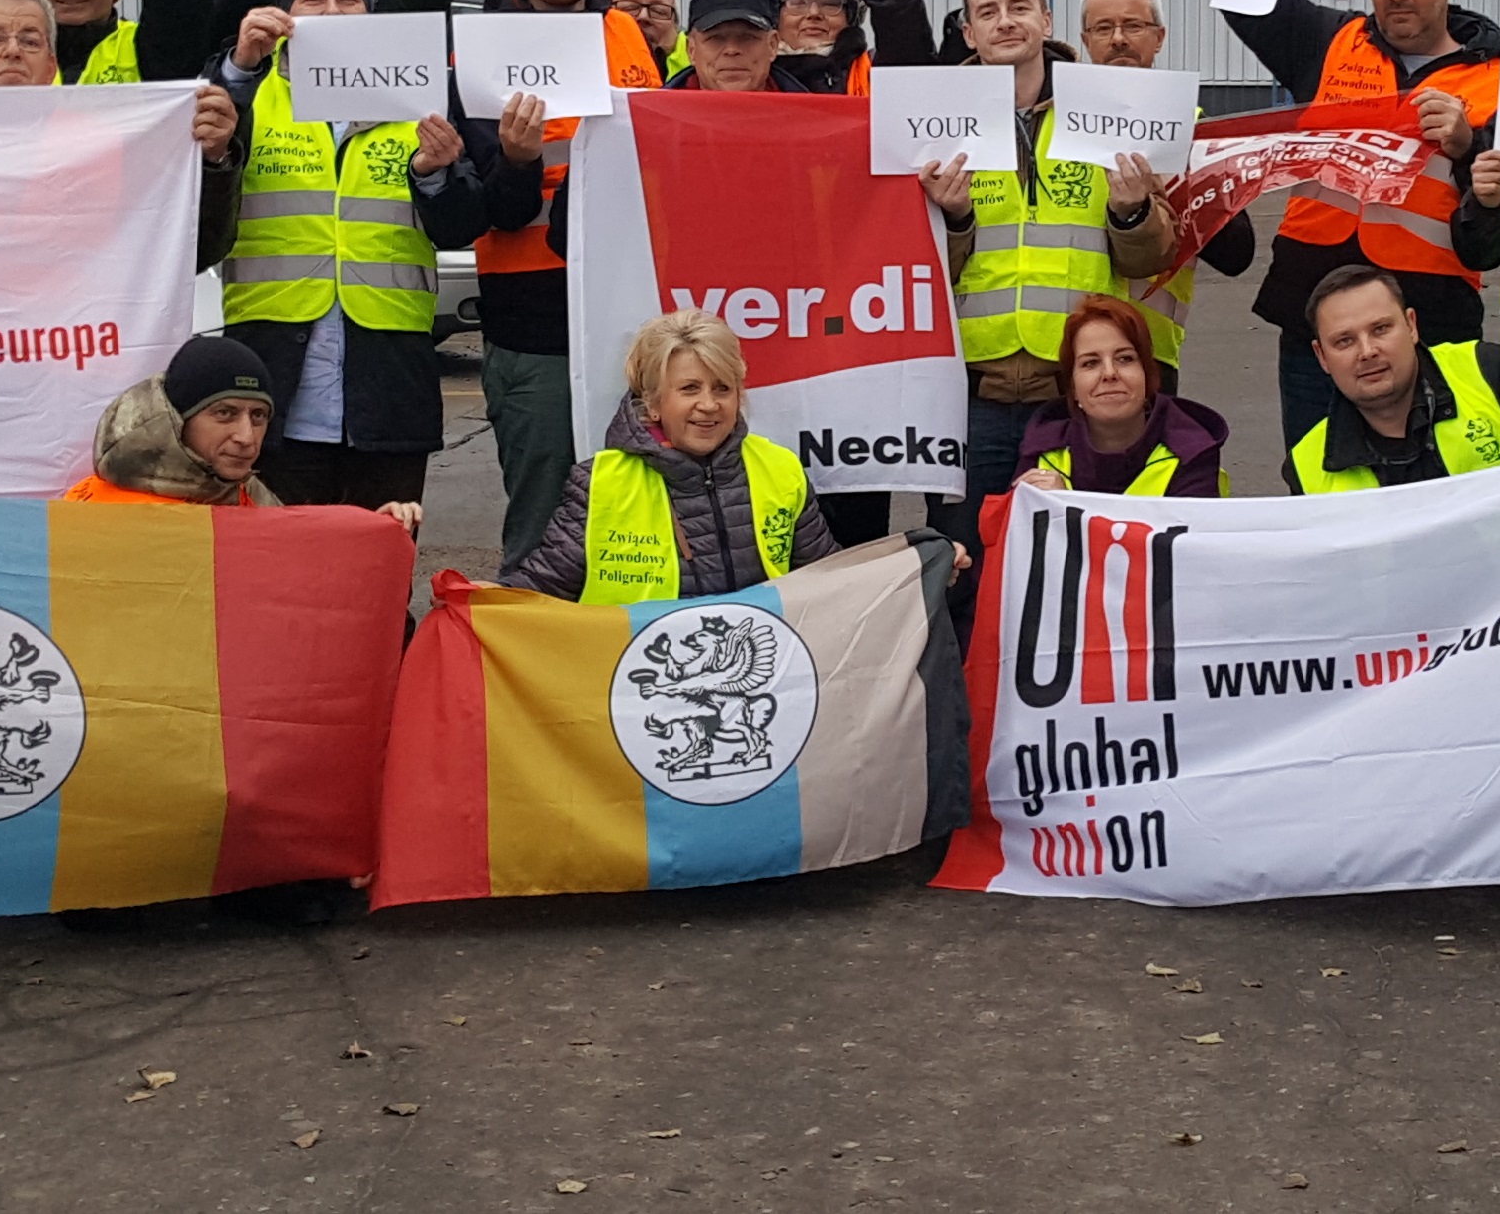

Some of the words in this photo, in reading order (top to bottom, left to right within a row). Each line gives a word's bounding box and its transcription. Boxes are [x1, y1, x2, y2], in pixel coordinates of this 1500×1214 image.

[308, 65, 430, 89] THANKS
[505, 63, 561, 87] FOR
[906, 116, 982, 140] YOUR
[1066, 111, 1183, 143] SUPPORT
[670, 264, 934, 340] ver.di
[598, 548, 668, 568] Zawodowy
[607, 529, 661, 547] Związek
[598, 568, 666, 585] Poligrafów
[1029, 794, 1168, 878] union
